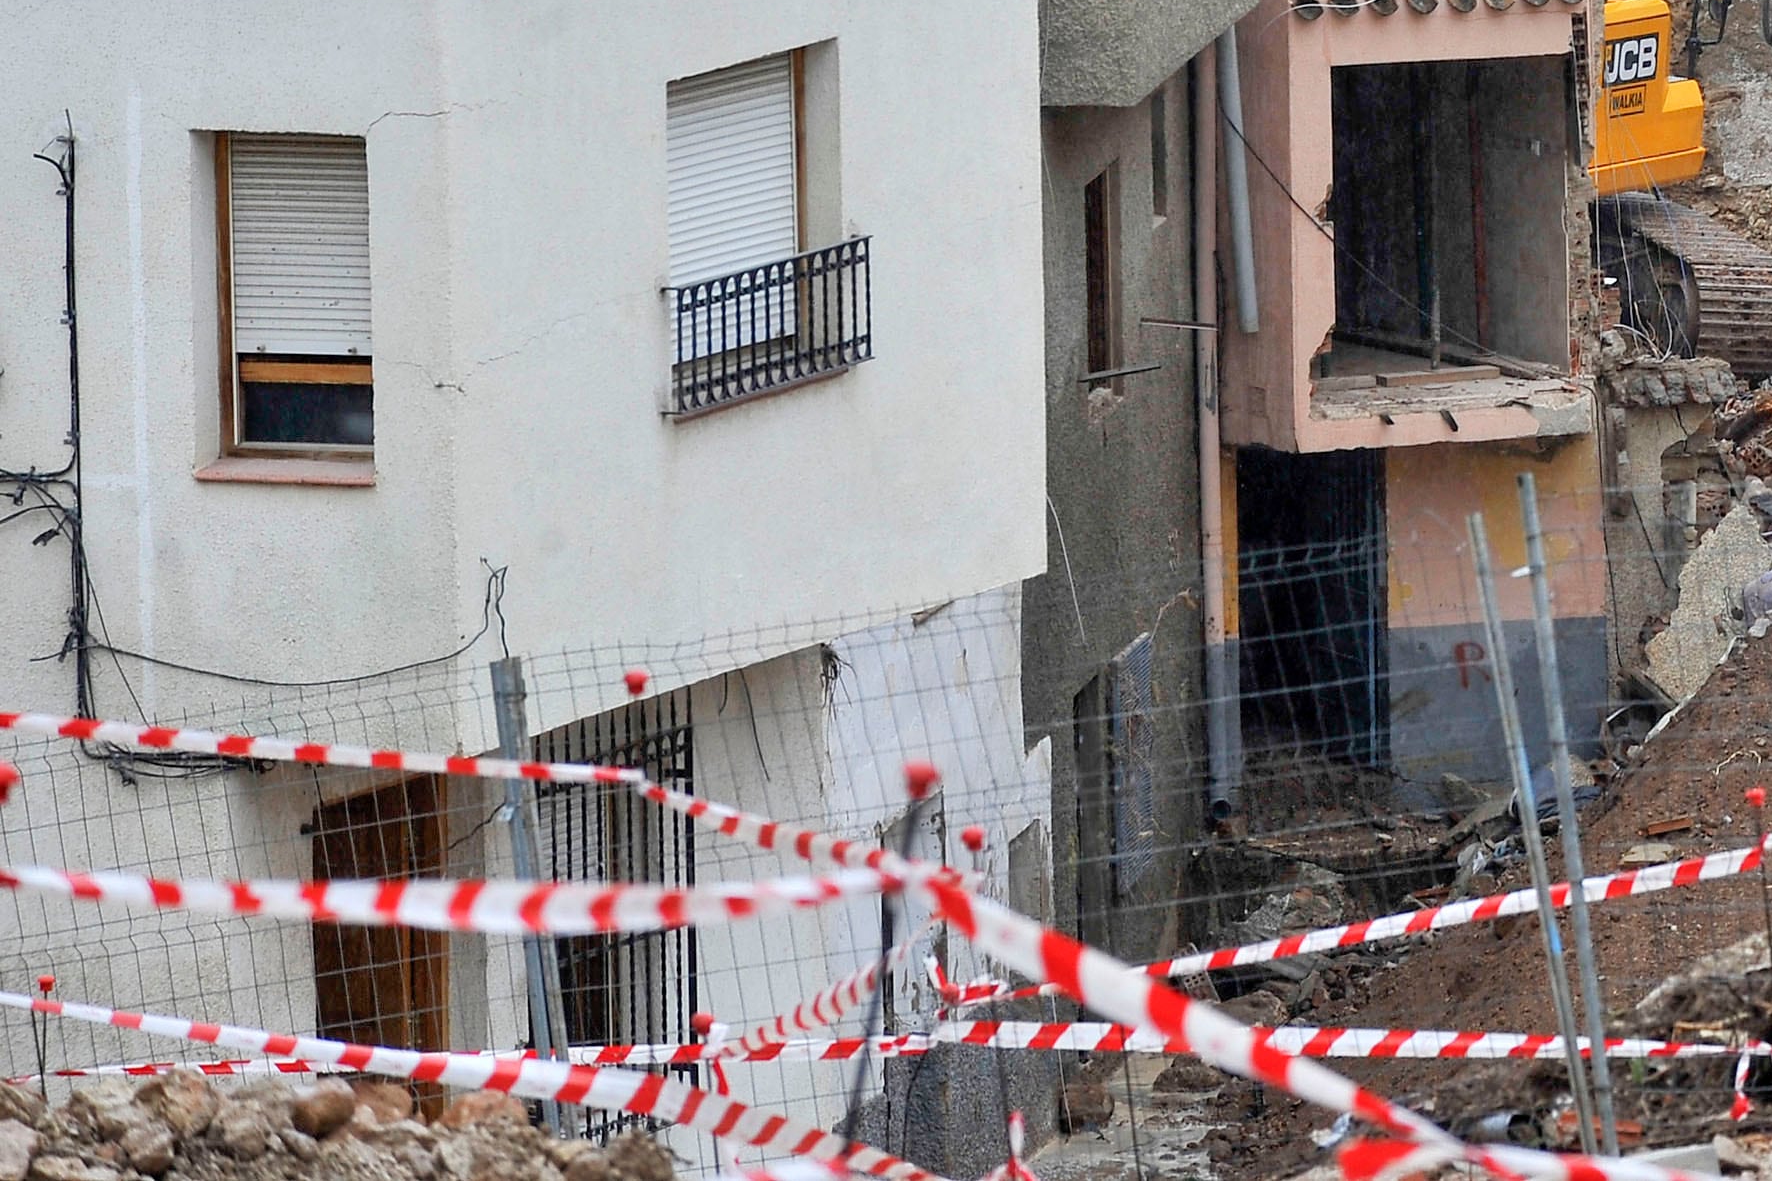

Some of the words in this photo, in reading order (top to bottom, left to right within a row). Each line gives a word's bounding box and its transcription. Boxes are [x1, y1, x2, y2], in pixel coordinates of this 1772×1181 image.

[1604, 37, 1657, 84] JCB
[1612, 92, 1643, 111] WALKIA
[1454, 640, 1491, 689] R
